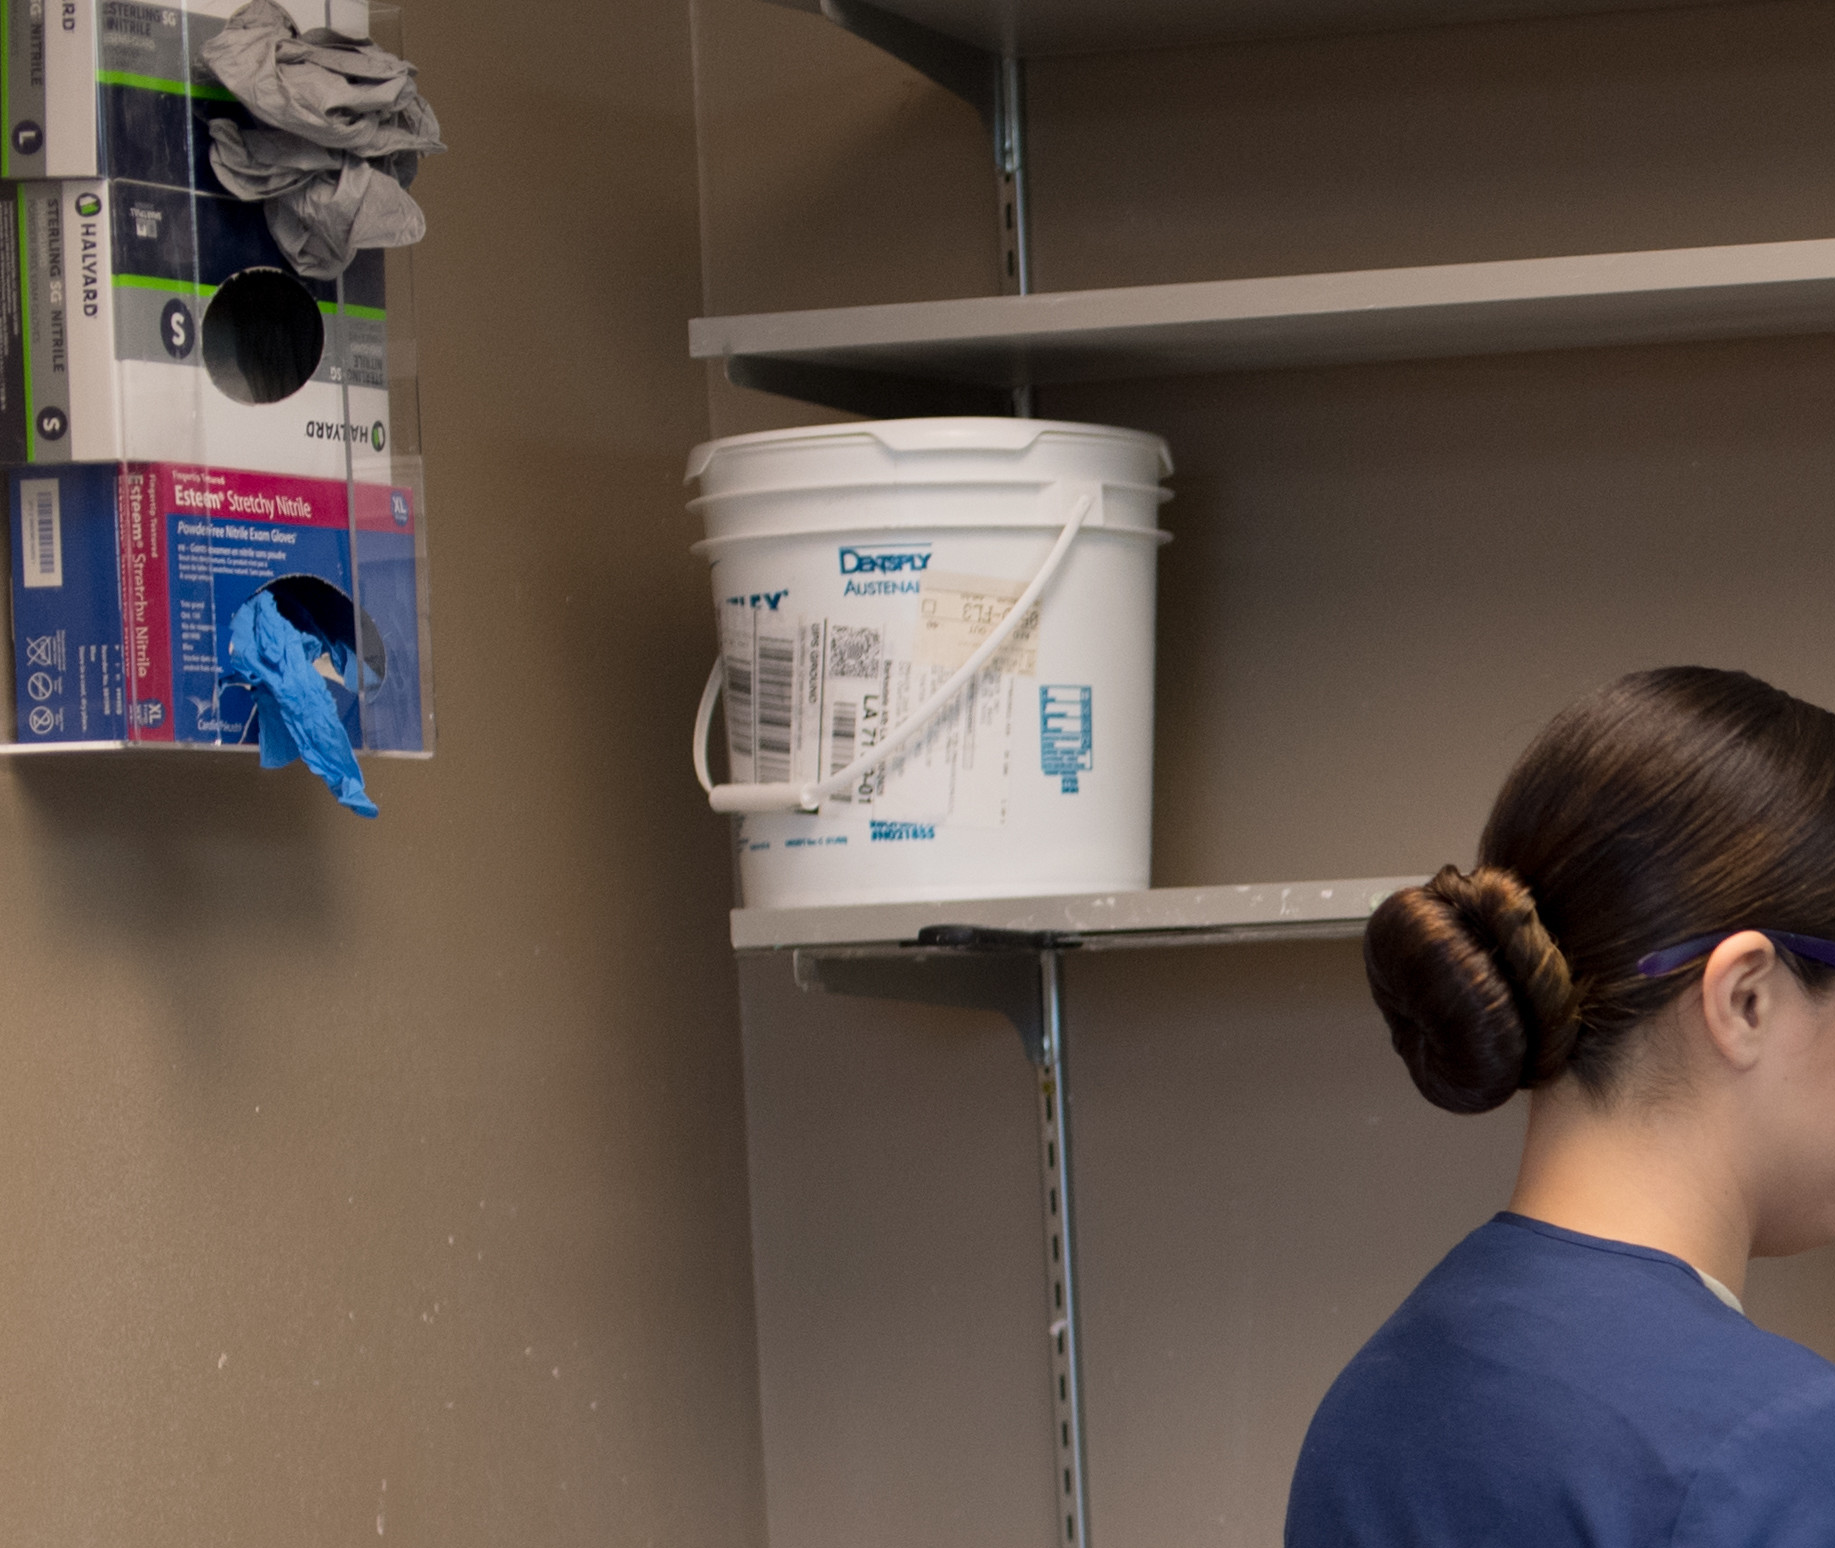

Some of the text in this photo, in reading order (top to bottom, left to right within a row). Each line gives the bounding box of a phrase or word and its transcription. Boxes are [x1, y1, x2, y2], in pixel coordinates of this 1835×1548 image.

[30, 23, 43, 86] NITRILE
[49, 200, 64, 372] STERLING SG NITRILE
[81, 223, 97, 318] HALYARD
[170, 312, 186, 346] S
[227, 491, 274, 519] Stretchy
[277, 496, 311, 518] Nitrile
[136, 626, 150, 678] Nitrile
